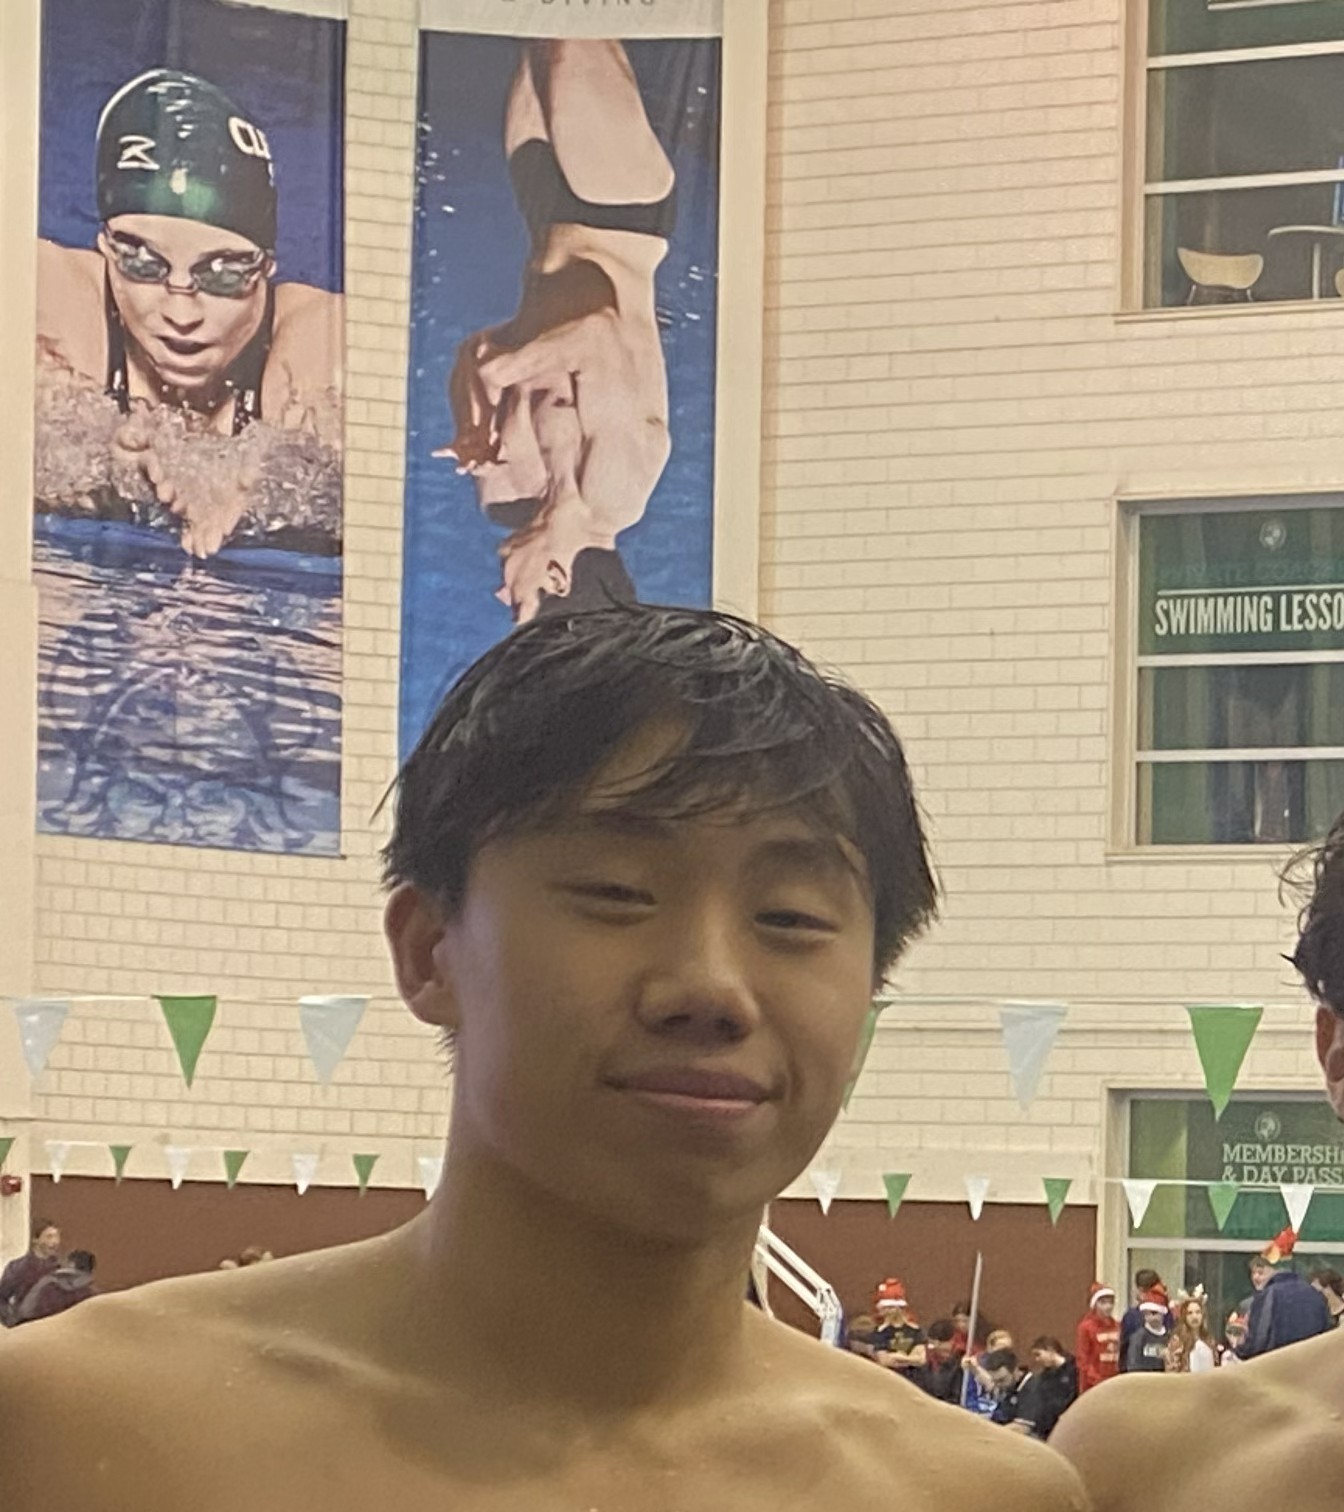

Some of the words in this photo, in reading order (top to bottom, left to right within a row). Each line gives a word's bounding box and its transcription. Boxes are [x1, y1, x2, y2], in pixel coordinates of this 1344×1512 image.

[1154, 594, 1273, 636] SWIMMING
[1222, 1165, 1237, 1182] &
[1243, 1165, 1288, 1184] DAY
